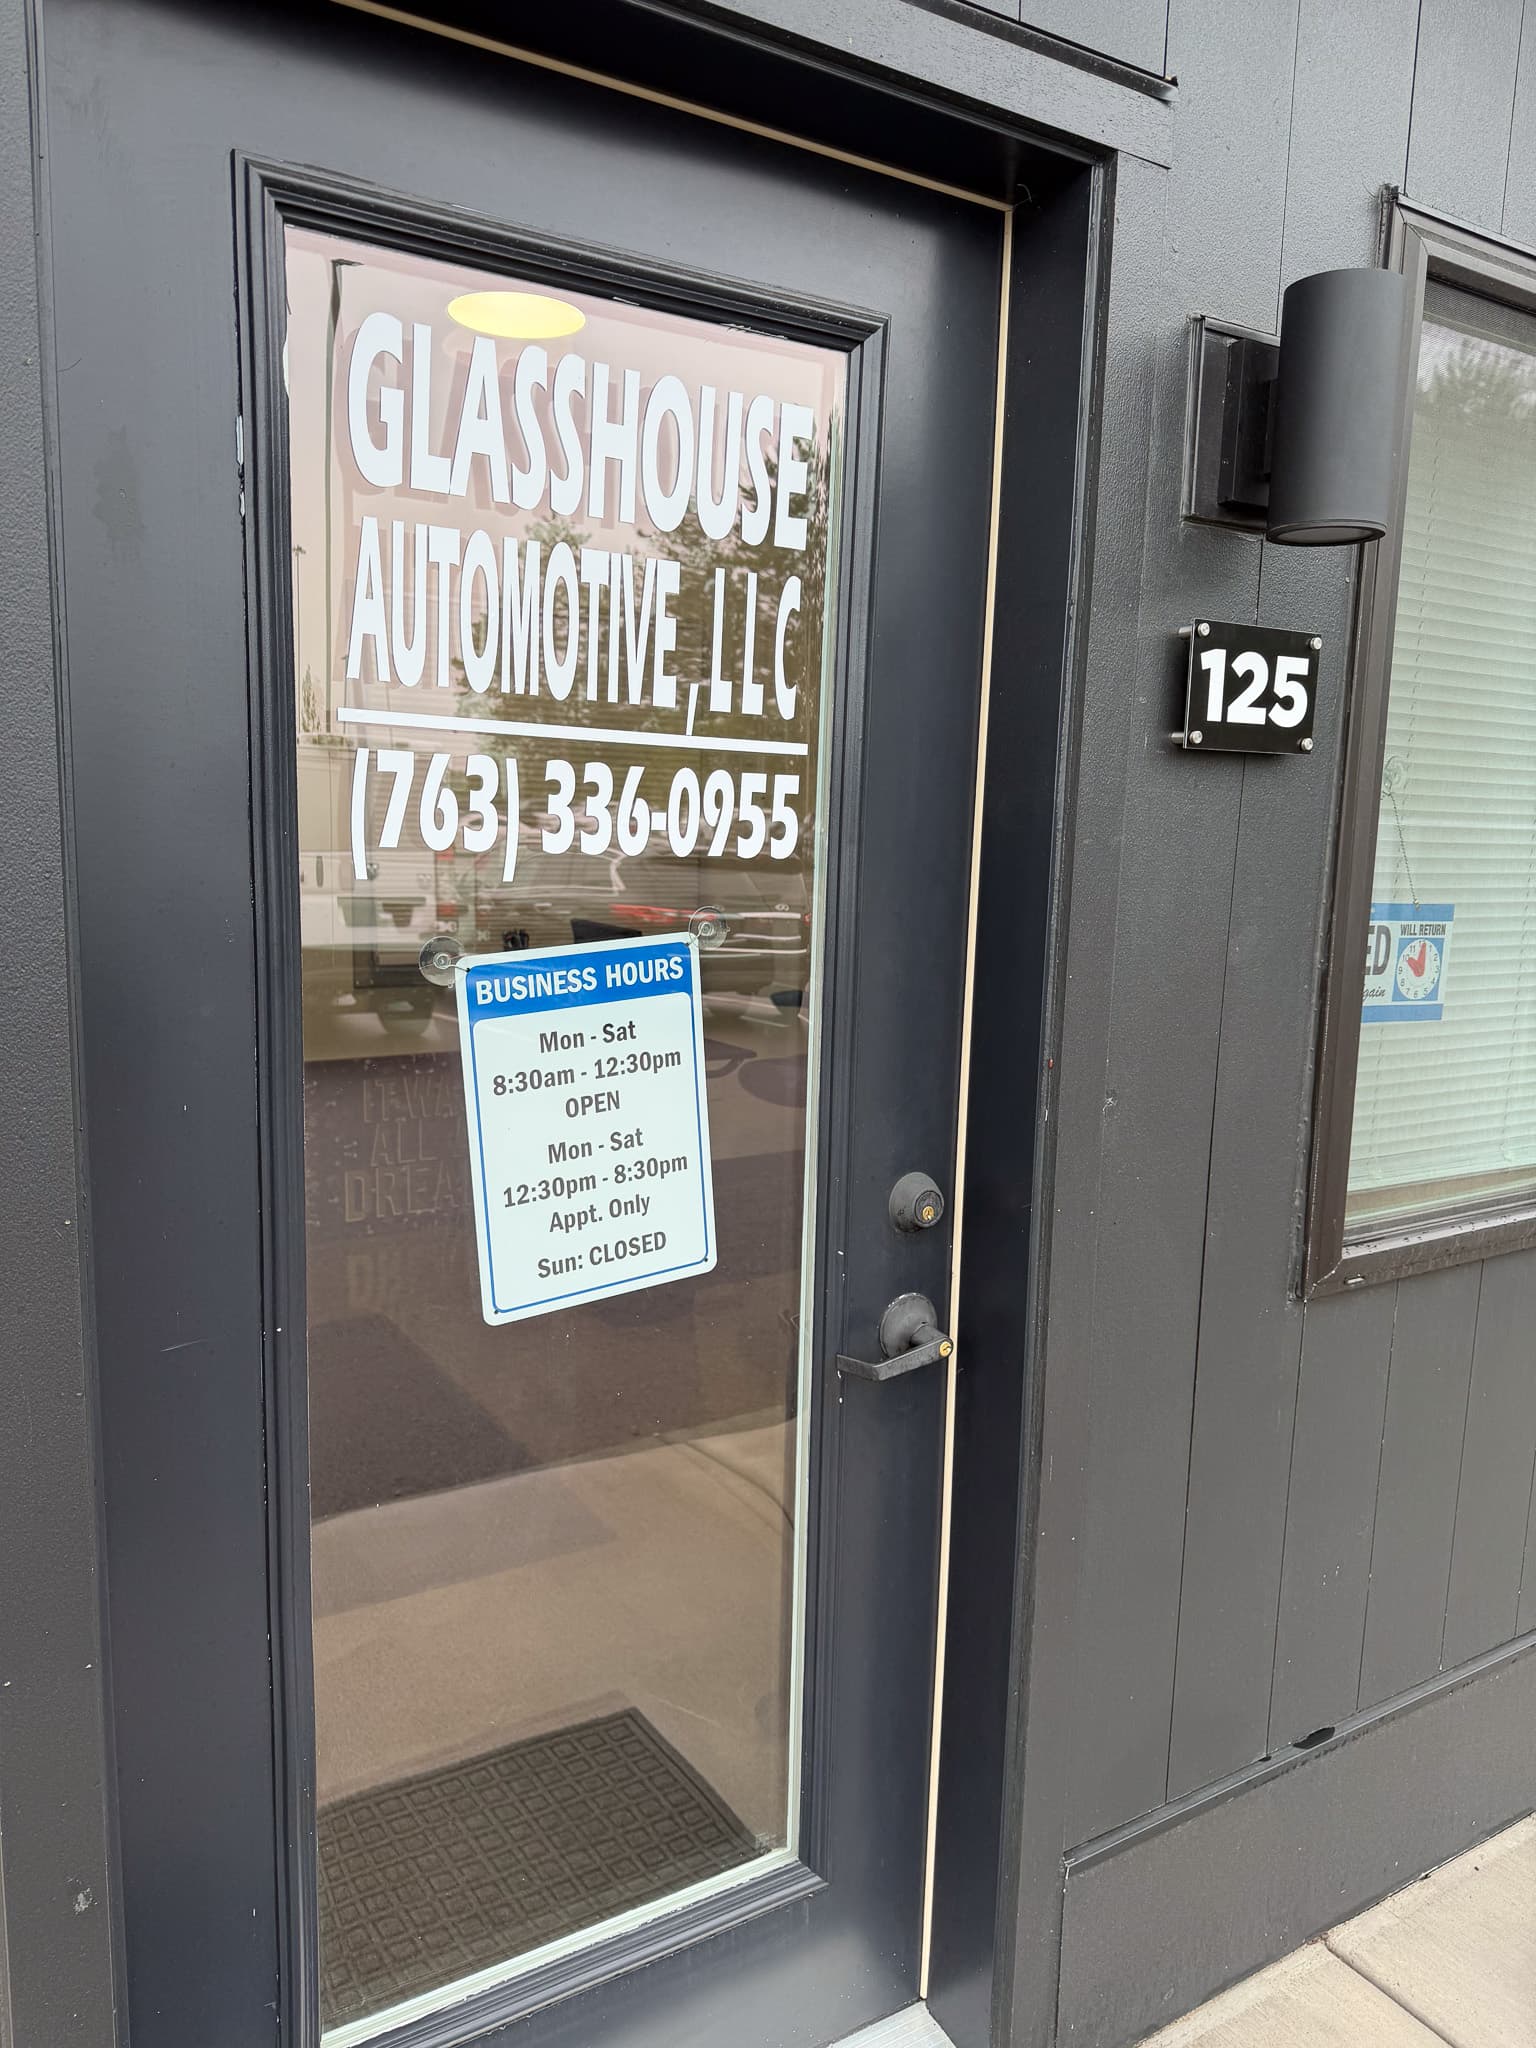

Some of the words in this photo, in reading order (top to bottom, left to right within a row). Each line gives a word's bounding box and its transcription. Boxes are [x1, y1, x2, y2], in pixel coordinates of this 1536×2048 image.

[347, 312, 815, 551] GLASSHOUSE
[709, 567, 802, 721] LLC
[1200, 649, 1310, 728] 125
[351, 747, 518, 883] (763)
[541, 759, 801, 859] 336-0955
[1400, 924, 1417, 936] WILL
[1419, 924, 1447, 936] RETURN
[476, 967, 598, 1006] BUSINESS
[605, 956, 685, 988] HOURS
[1363, 986, 1386, 1001] gain
[539, 1028, 586, 1054] Mon
[601, 1020, 637, 1044] Sat
[492, 1069, 576, 1096] 8:30am
[593, 1049, 683, 1082] 12:30pm
[564, 1090, 621, 1119] OPEN
[547, 1139, 594, 1165] Mon
[609, 1128, 644, 1153] Sat
[503, 1172, 598, 1209] 12:30pm
[613, 1155, 689, 1185] 8:30pm
[548, 1204, 603, 1235] Appt.
[608, 1193, 652, 1219] Only
[537, 1254, 584, 1280] Sun:
[589, 1231, 668, 1269] CLOSED
